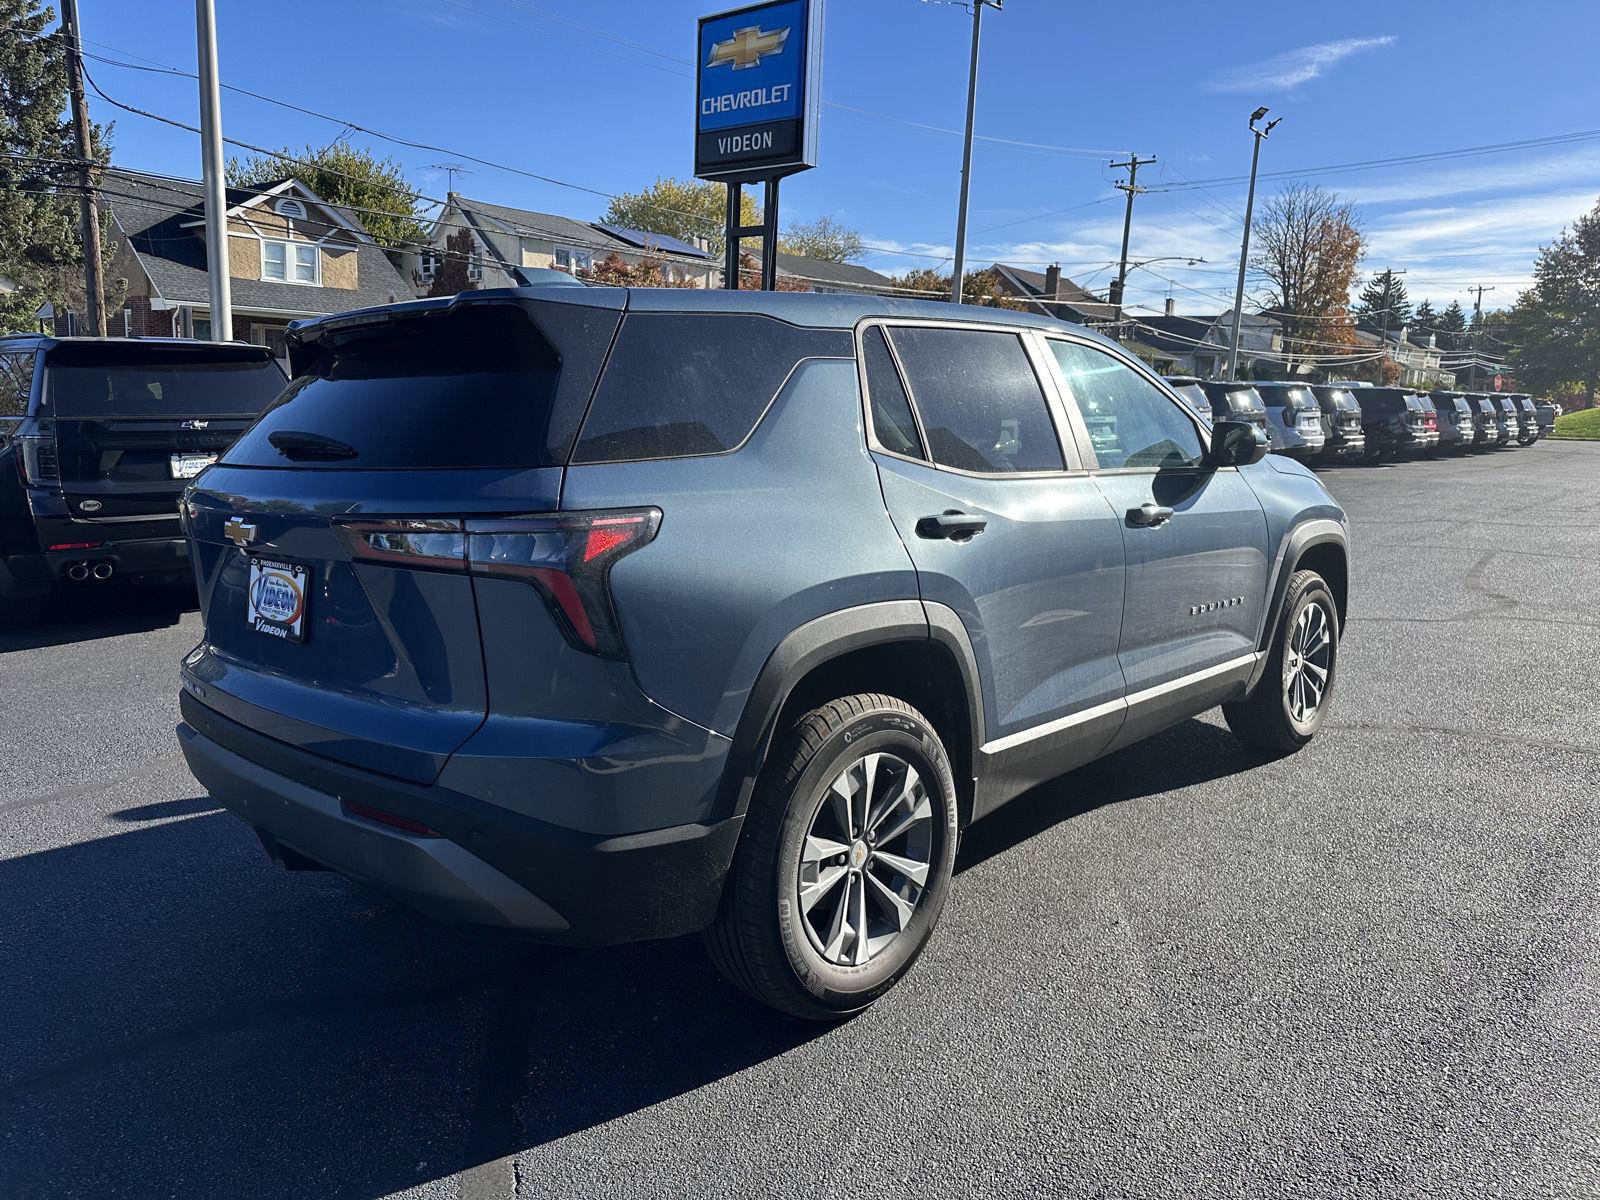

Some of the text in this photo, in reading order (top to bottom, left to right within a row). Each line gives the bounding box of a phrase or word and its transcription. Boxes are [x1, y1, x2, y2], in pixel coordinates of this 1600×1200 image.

[702, 84, 791, 115] CHEVROLET
[718, 131, 772, 154] VIDEON
[178, 459, 210, 472] VIDEO
[260, 559, 293, 571] PHOENIXVILLE
[1191, 596, 1244, 615] EQUINOX
[256, 619, 288, 638] VIDEON
